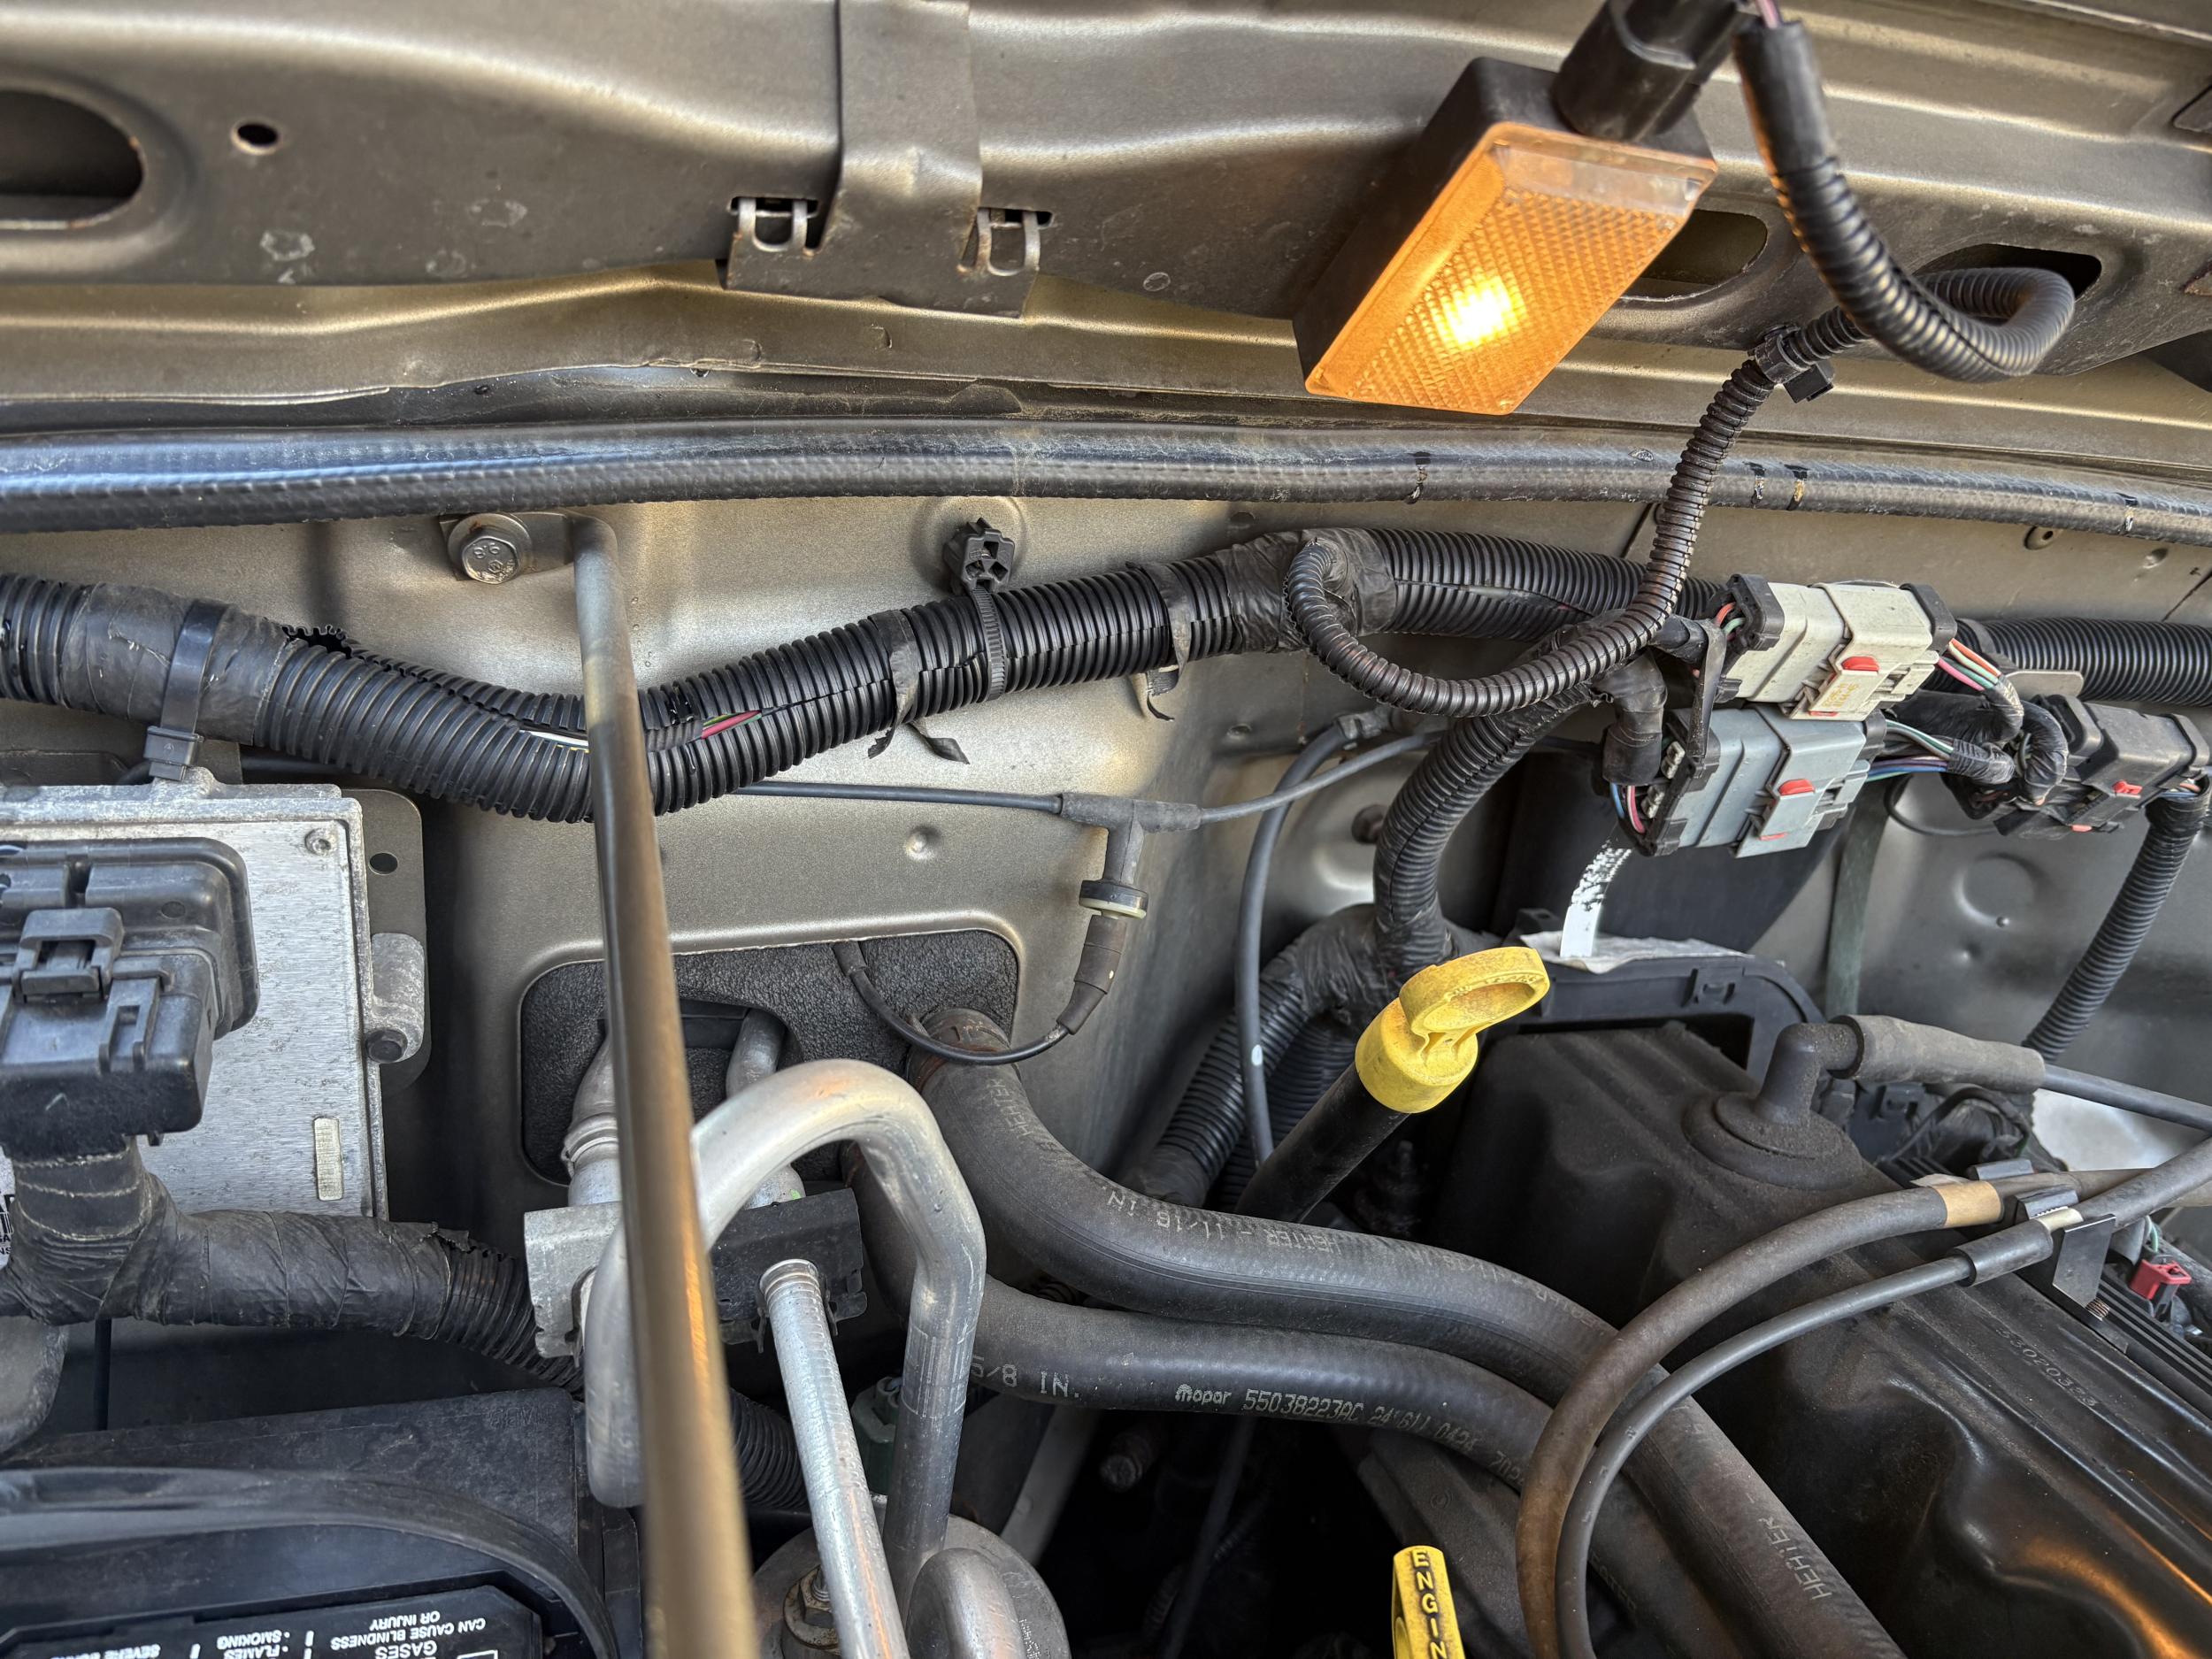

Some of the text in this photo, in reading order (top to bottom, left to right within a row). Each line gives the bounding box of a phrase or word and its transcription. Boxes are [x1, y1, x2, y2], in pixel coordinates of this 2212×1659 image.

[1242, 1387, 1364, 1423] 55038223AC
[1410, 1548, 1448, 1659] ENGIN
[330, 1617, 486, 1651] CAN CAUSE BLINDNESS
[369, 1610, 441, 1632] OR INJURY
[217, 1630, 282, 1650] SMOKING
[374, 1640, 438, 1659] GASES
